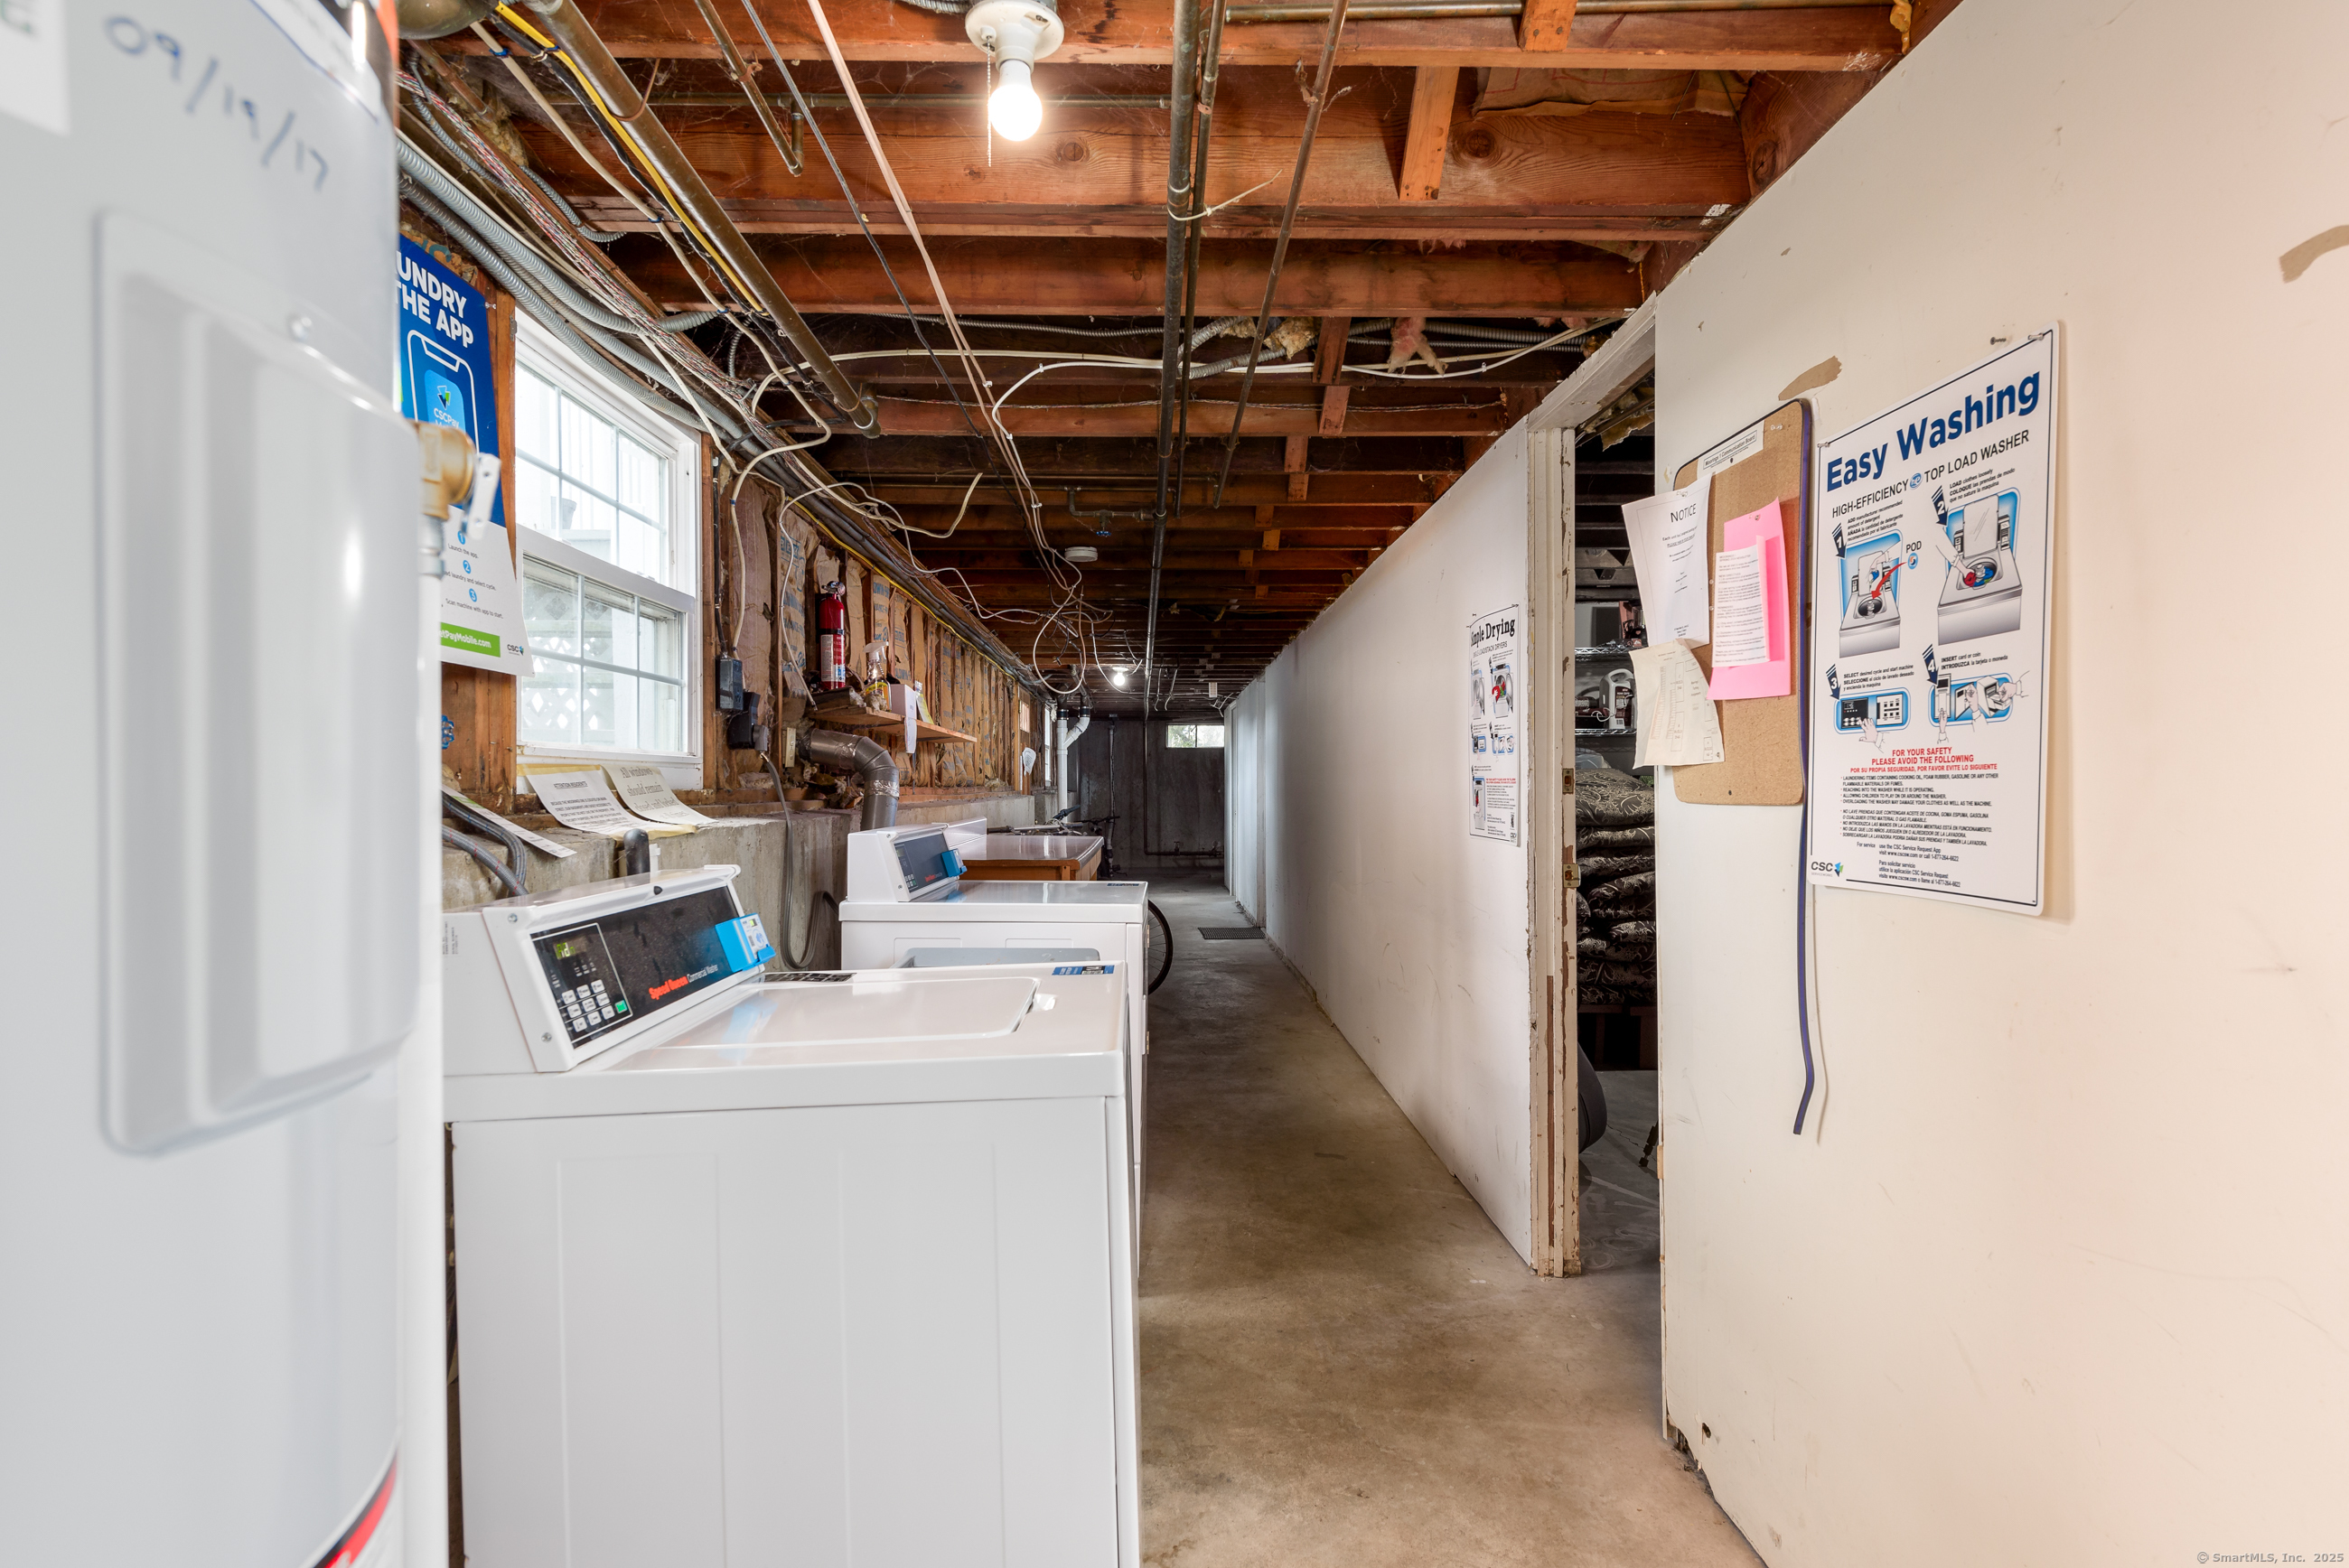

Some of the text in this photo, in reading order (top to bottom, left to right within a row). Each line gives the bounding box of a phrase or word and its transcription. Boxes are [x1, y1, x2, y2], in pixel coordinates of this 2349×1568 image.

[105, 15, 328, 191] 09/19/17
[395, 250, 467, 319] UNDRY
[435, 308, 474, 349] APP
[1827, 371, 2040, 492] Easy Washing
[1745, 434, 1755, 444] Board
[1832, 478, 1908, 519] HIGH-EFFICIENCY
[1924, 464, 1944, 483] TOP
[1948, 449, 1978, 475] LOAD
[1980, 429, 2029, 461] WASHER
[1963, 475, 1977, 483] clothes
[1979, 469, 1993, 479] loosely
[1950, 484, 1971, 495] COLOQUE
[1979, 475, 1996, 486] prendas
[2004, 468, 2015, 476] modo
[1671, 503, 1697, 523] NOTICE
[1937, 500, 1945, 515] 2
[459, 531, 464, 544] 1
[1837, 537, 1843, 548] 1
[1906, 540, 1922, 554] POD
[463, 562, 470, 572] 2
[471, 591, 476, 601] 3
[1471, 618, 1515, 648] imple Drying
[507, 644, 519, 652] CSC
[1495, 640, 1507, 650] DRYERS
[1928, 658, 1935, 673] 4
[1942, 661, 1970, 669] INTRODUZCA
[1830, 677, 1838, 690] 3
[1927, 747, 1951, 755] SAFETY
[1934, 755, 1973, 763] FOLLOWING
[621, 768, 631, 778] All
[627, 784, 646, 796] should
[1811, 861, 1833, 873] CSC
[687, 969, 707, 983] Commercial
